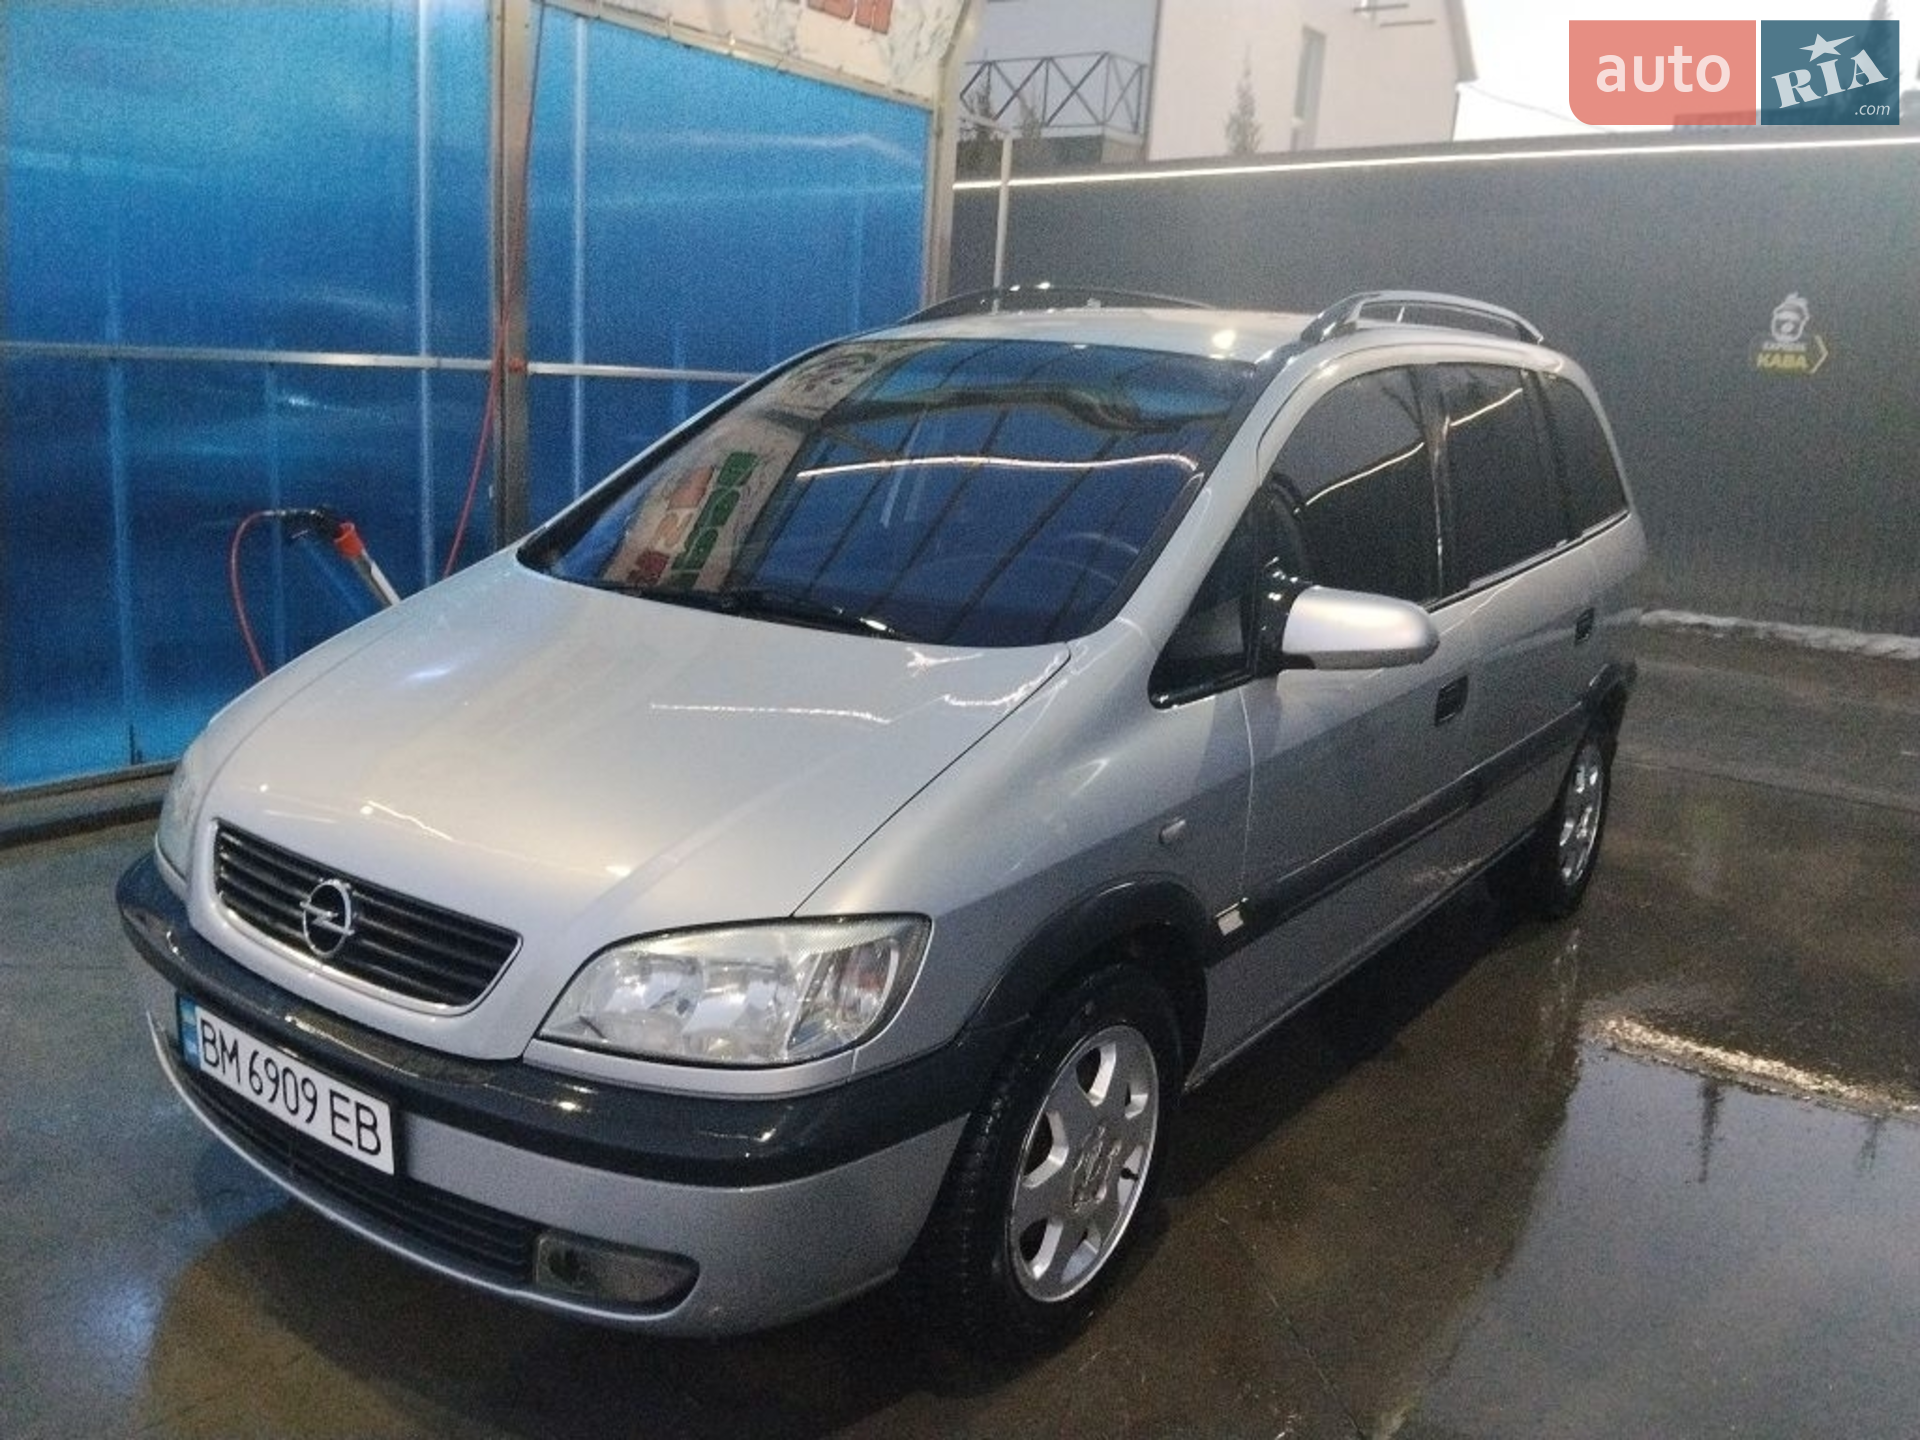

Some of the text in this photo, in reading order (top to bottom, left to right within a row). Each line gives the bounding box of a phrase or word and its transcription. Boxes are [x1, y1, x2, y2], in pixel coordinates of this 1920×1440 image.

[201, 1019, 382, 1156] BM 6909 EB
